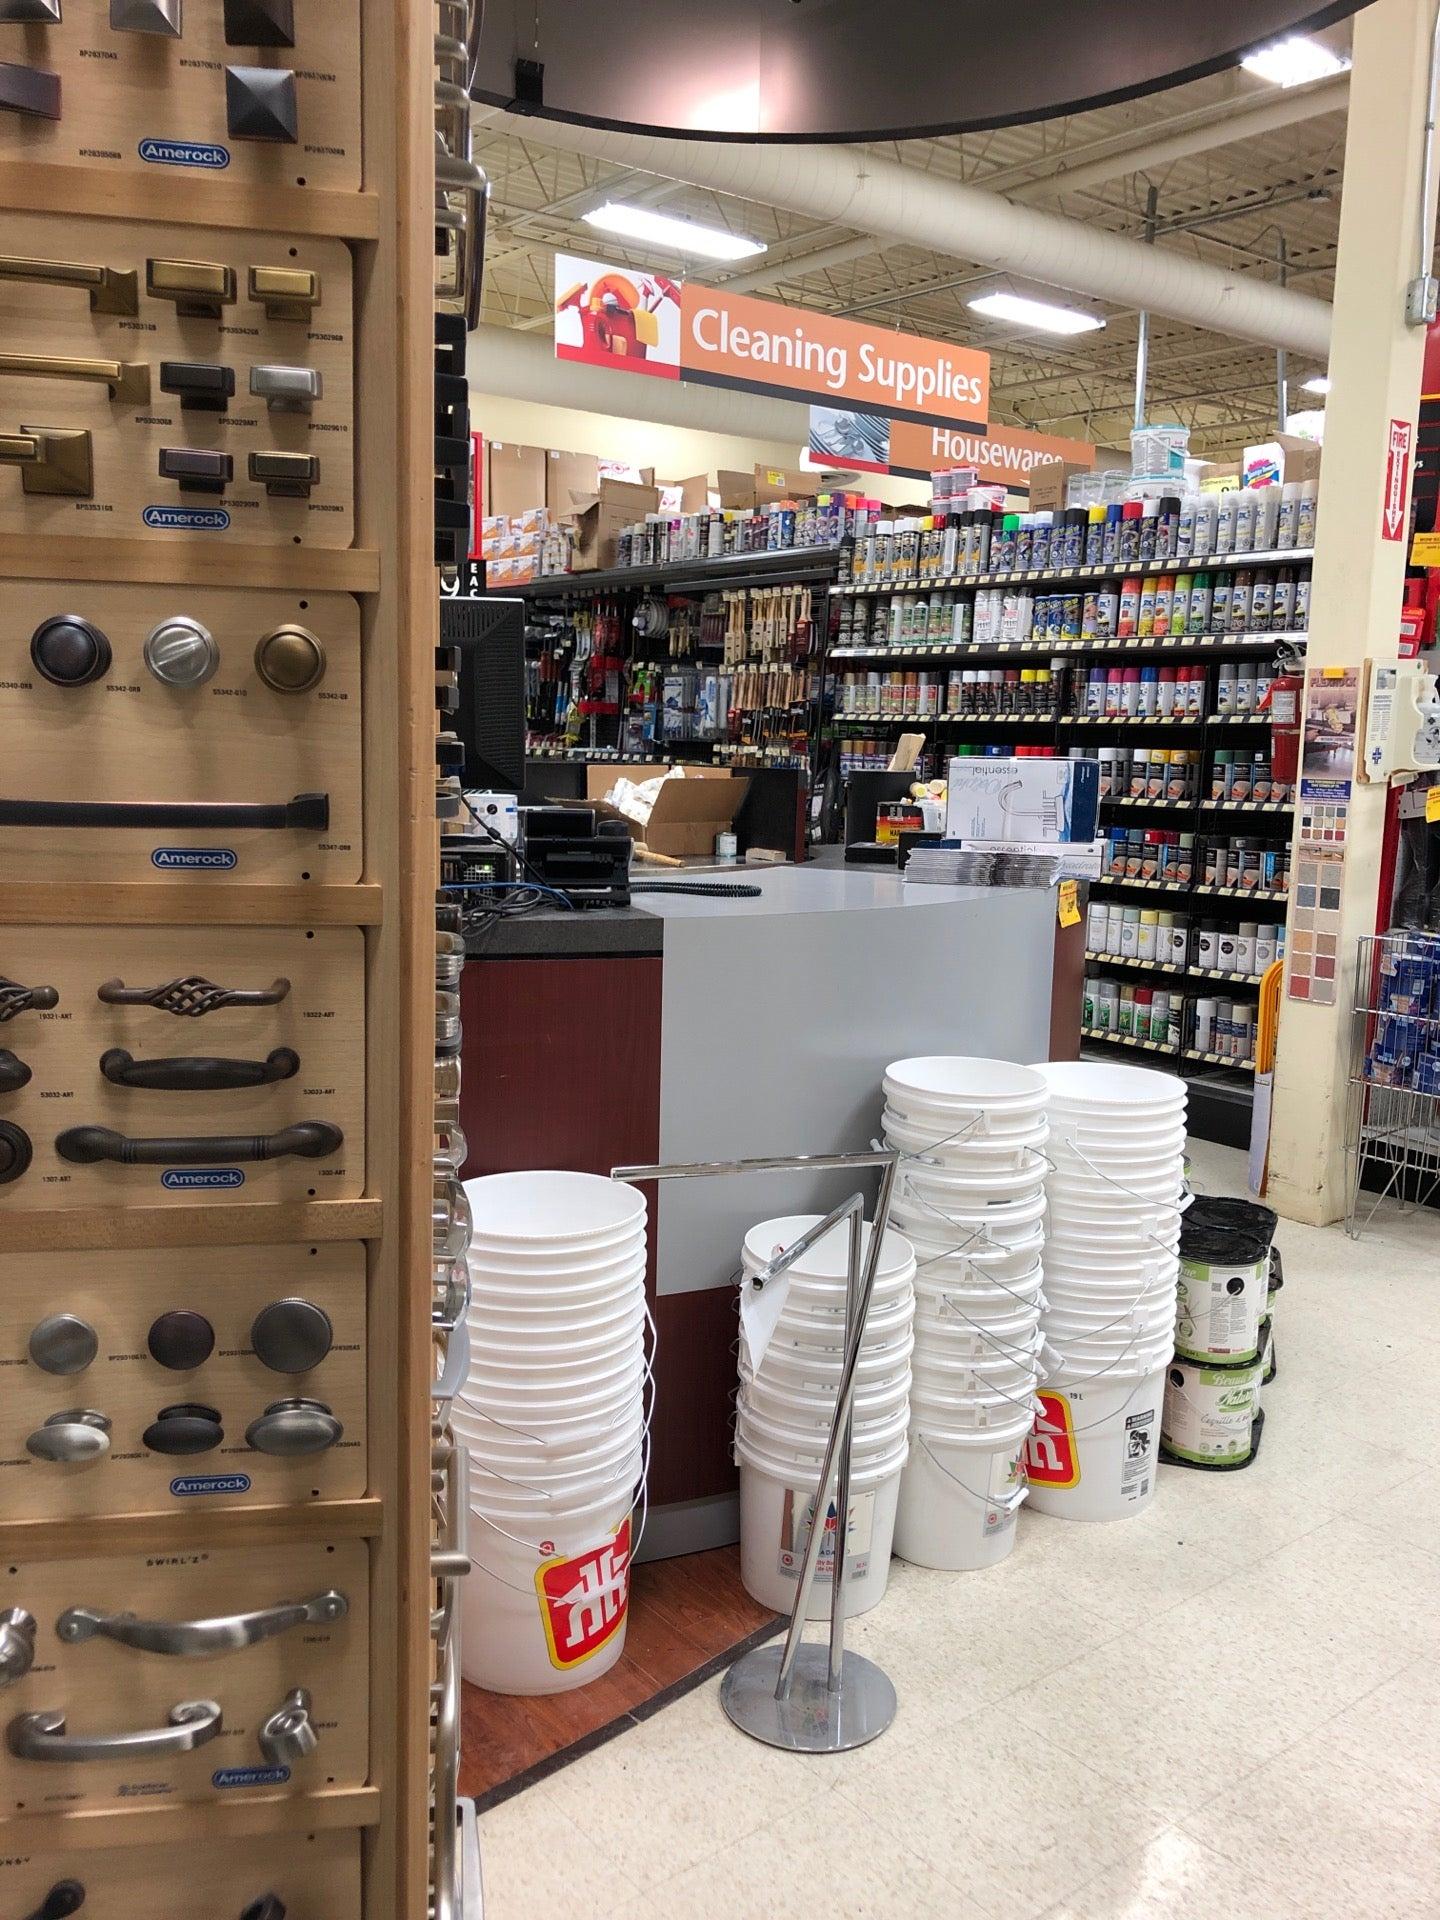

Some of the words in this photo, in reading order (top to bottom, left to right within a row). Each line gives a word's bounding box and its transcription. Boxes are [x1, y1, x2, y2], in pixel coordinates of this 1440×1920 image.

[144, 141, 223, 164] Amerock
[692, 308, 847, 389] Cleaning
[858, 343, 982, 405] Supplies
[1393, 430, 1407, 449] FIRE
[1390, 451, 1401, 530] EXTINGUISHER
[149, 510, 224, 526] Amerock
[972, 766, 1018, 776] essential
[158, 852, 231, 867] Amerock
[167, 1170, 239, 1186] Amerock
[176, 1477, 246, 1493] Amerock
[217, 1768, 288, 1786] Amerock
